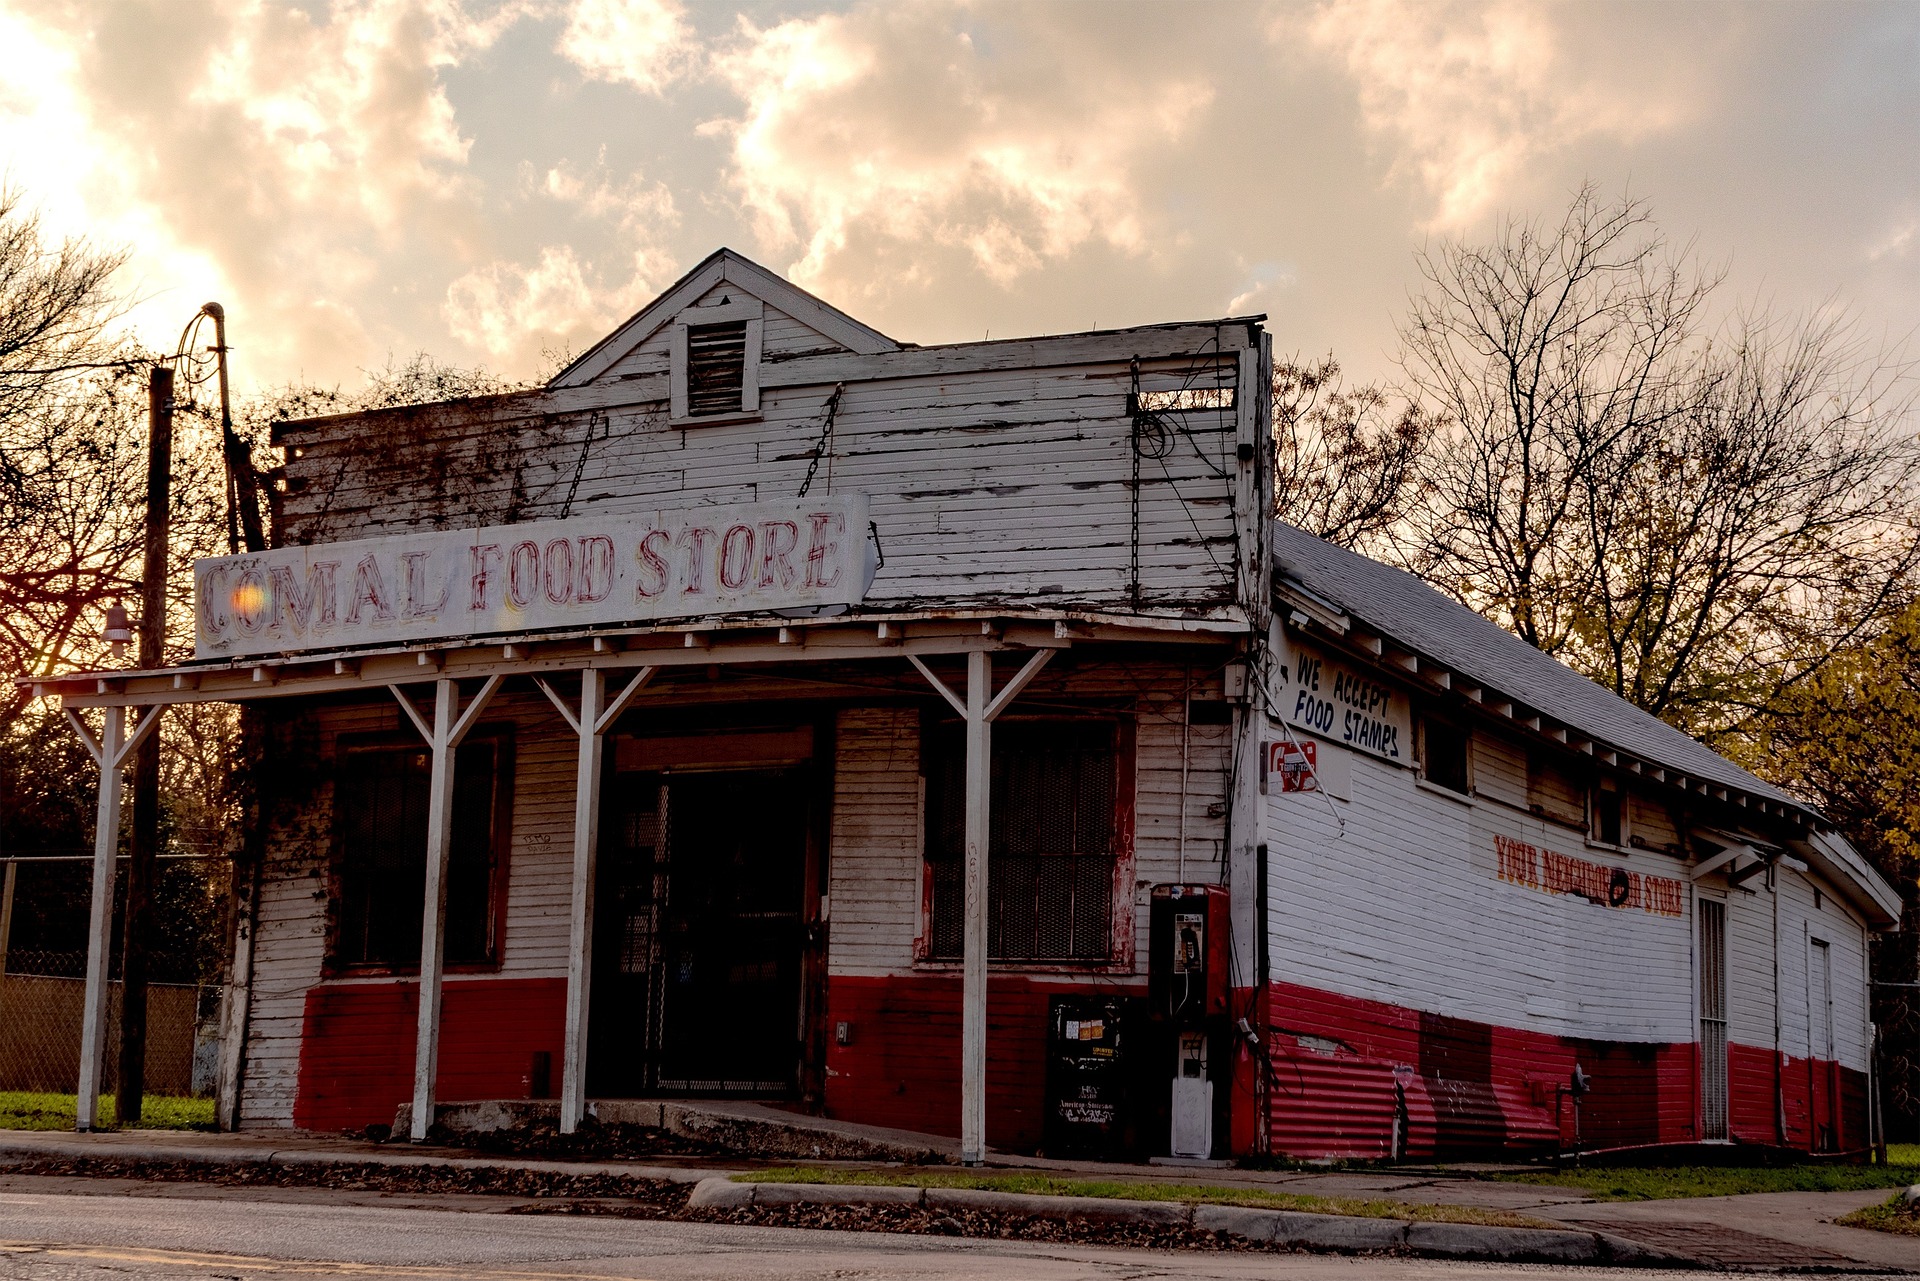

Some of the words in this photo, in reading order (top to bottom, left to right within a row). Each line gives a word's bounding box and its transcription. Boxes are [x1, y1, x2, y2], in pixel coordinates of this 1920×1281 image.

[200, 551, 450, 642] COMAL
[469, 534, 616, 612] FOOD
[633, 511, 846, 601] STORE
[1297, 652, 1322, 692] WE
[1333, 671, 1392, 718] ACCEPT
[1293, 689, 1335, 734] FOOD
[1343, 708, 1399, 758] STAMPS
[1493, 834, 1539, 890] YOUR
[1644, 875, 1683, 918] STORE
